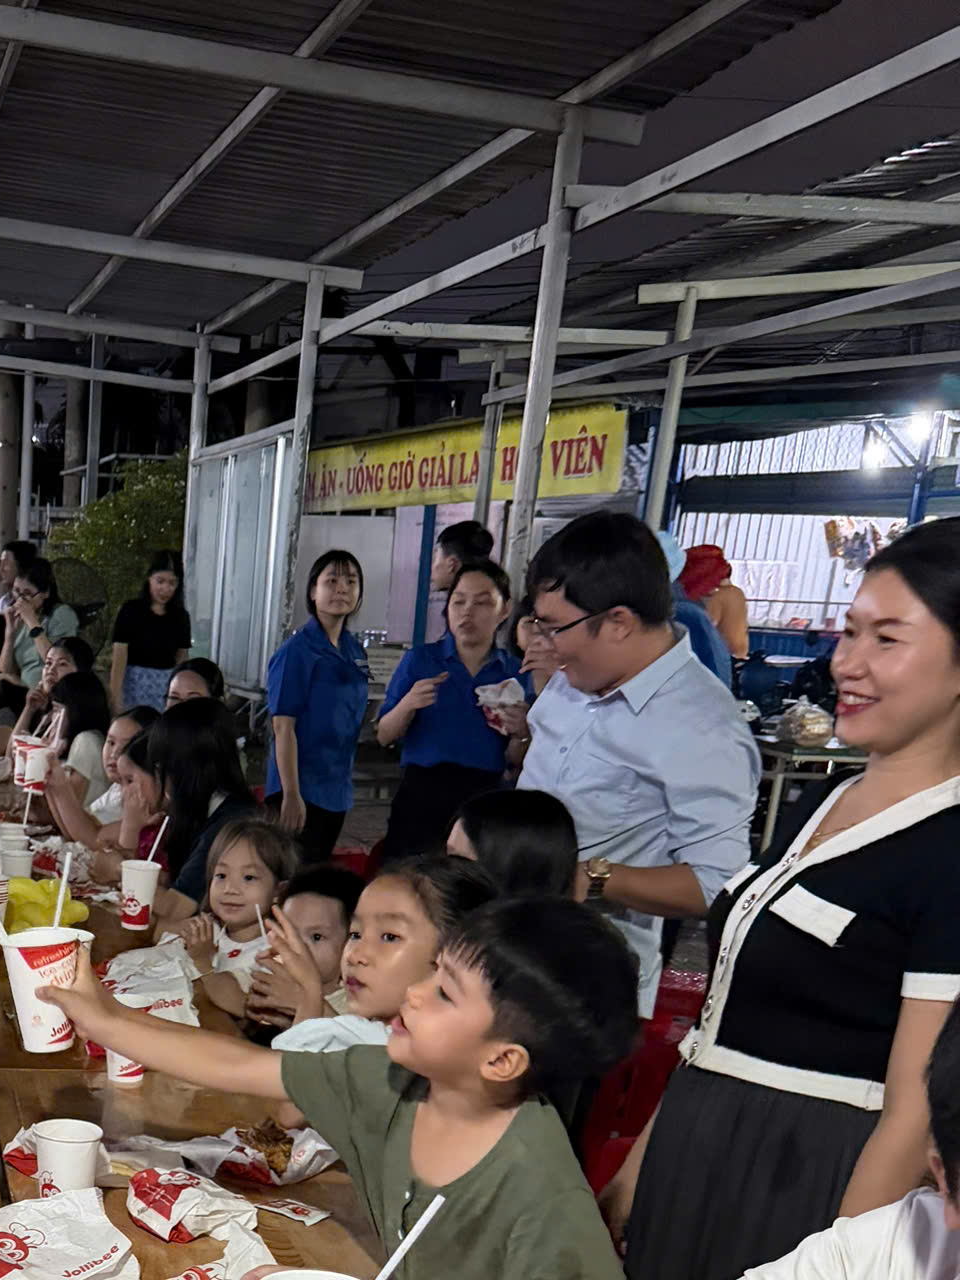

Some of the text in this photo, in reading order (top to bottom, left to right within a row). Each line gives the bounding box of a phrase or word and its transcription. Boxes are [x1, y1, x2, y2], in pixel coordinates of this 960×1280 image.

[347, 452, 385, 495] UỐNG
[418, 441, 456, 489] GIẢI
[458, 450, 480, 485] LA
[550, 424, 608, 481] VIÊN
[62, 1243, 120, 1279] Jollibee
